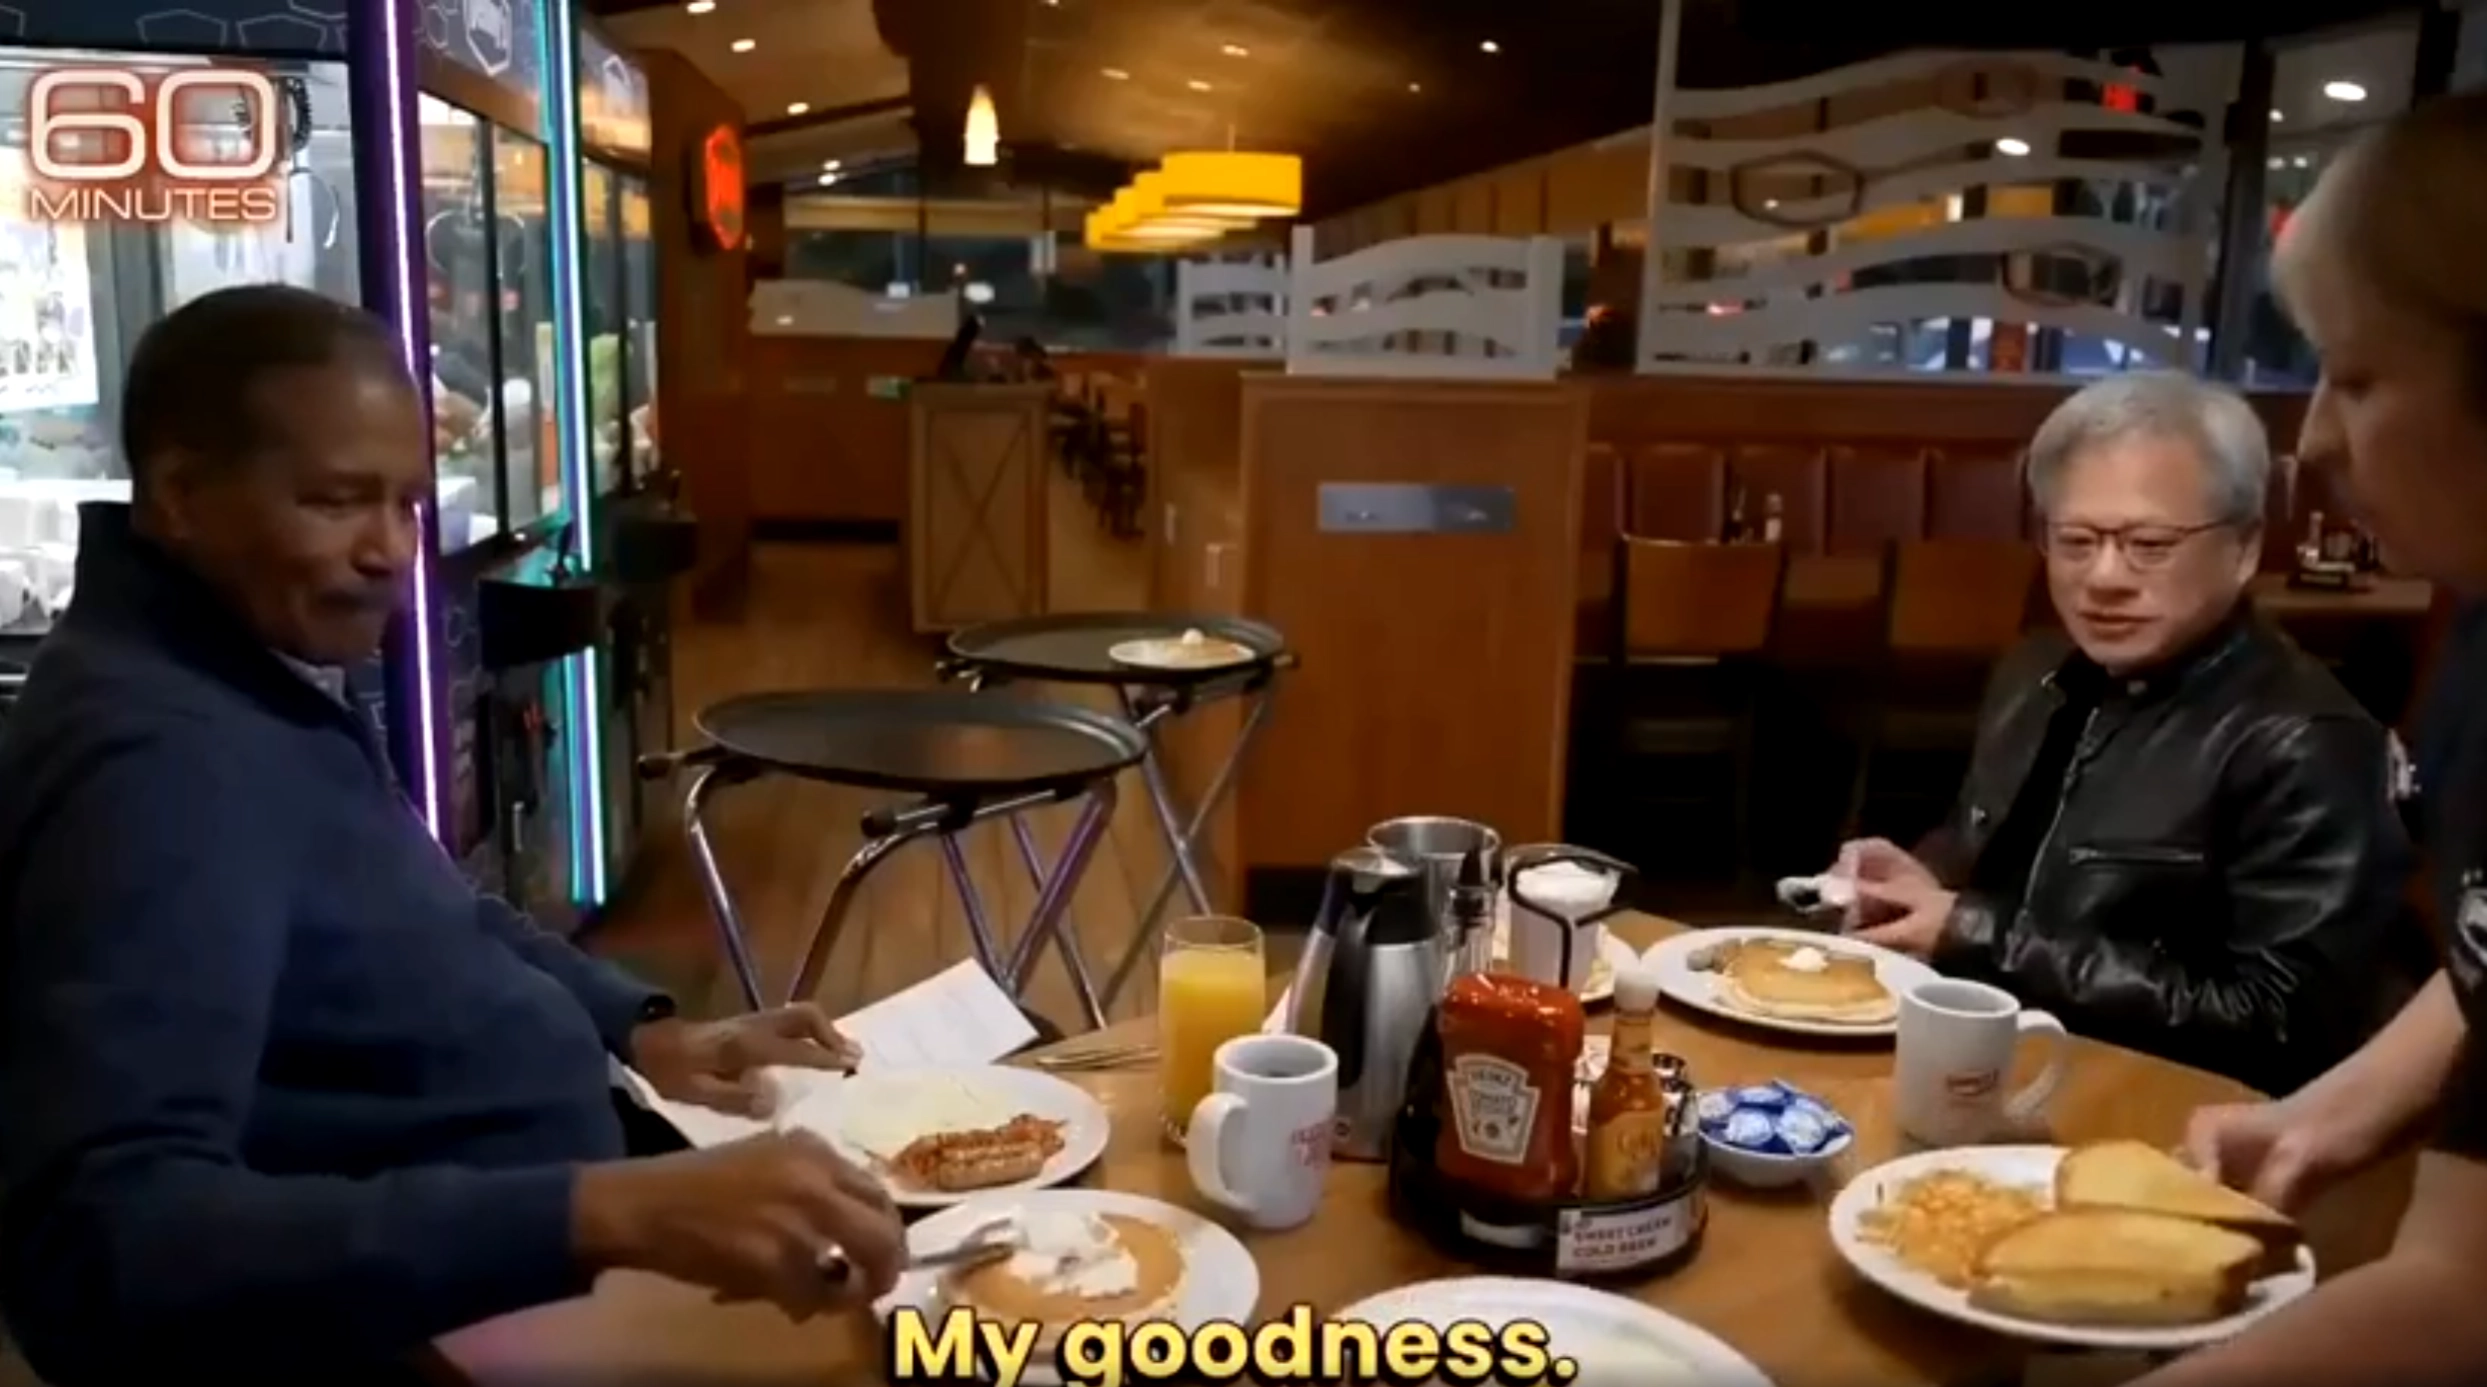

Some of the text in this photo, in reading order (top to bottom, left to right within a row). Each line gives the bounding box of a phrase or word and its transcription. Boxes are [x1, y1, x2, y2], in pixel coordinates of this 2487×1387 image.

[1574, 1226, 1625, 1242] SWEET
[1572, 1236, 1657, 1258] COLD BREW
